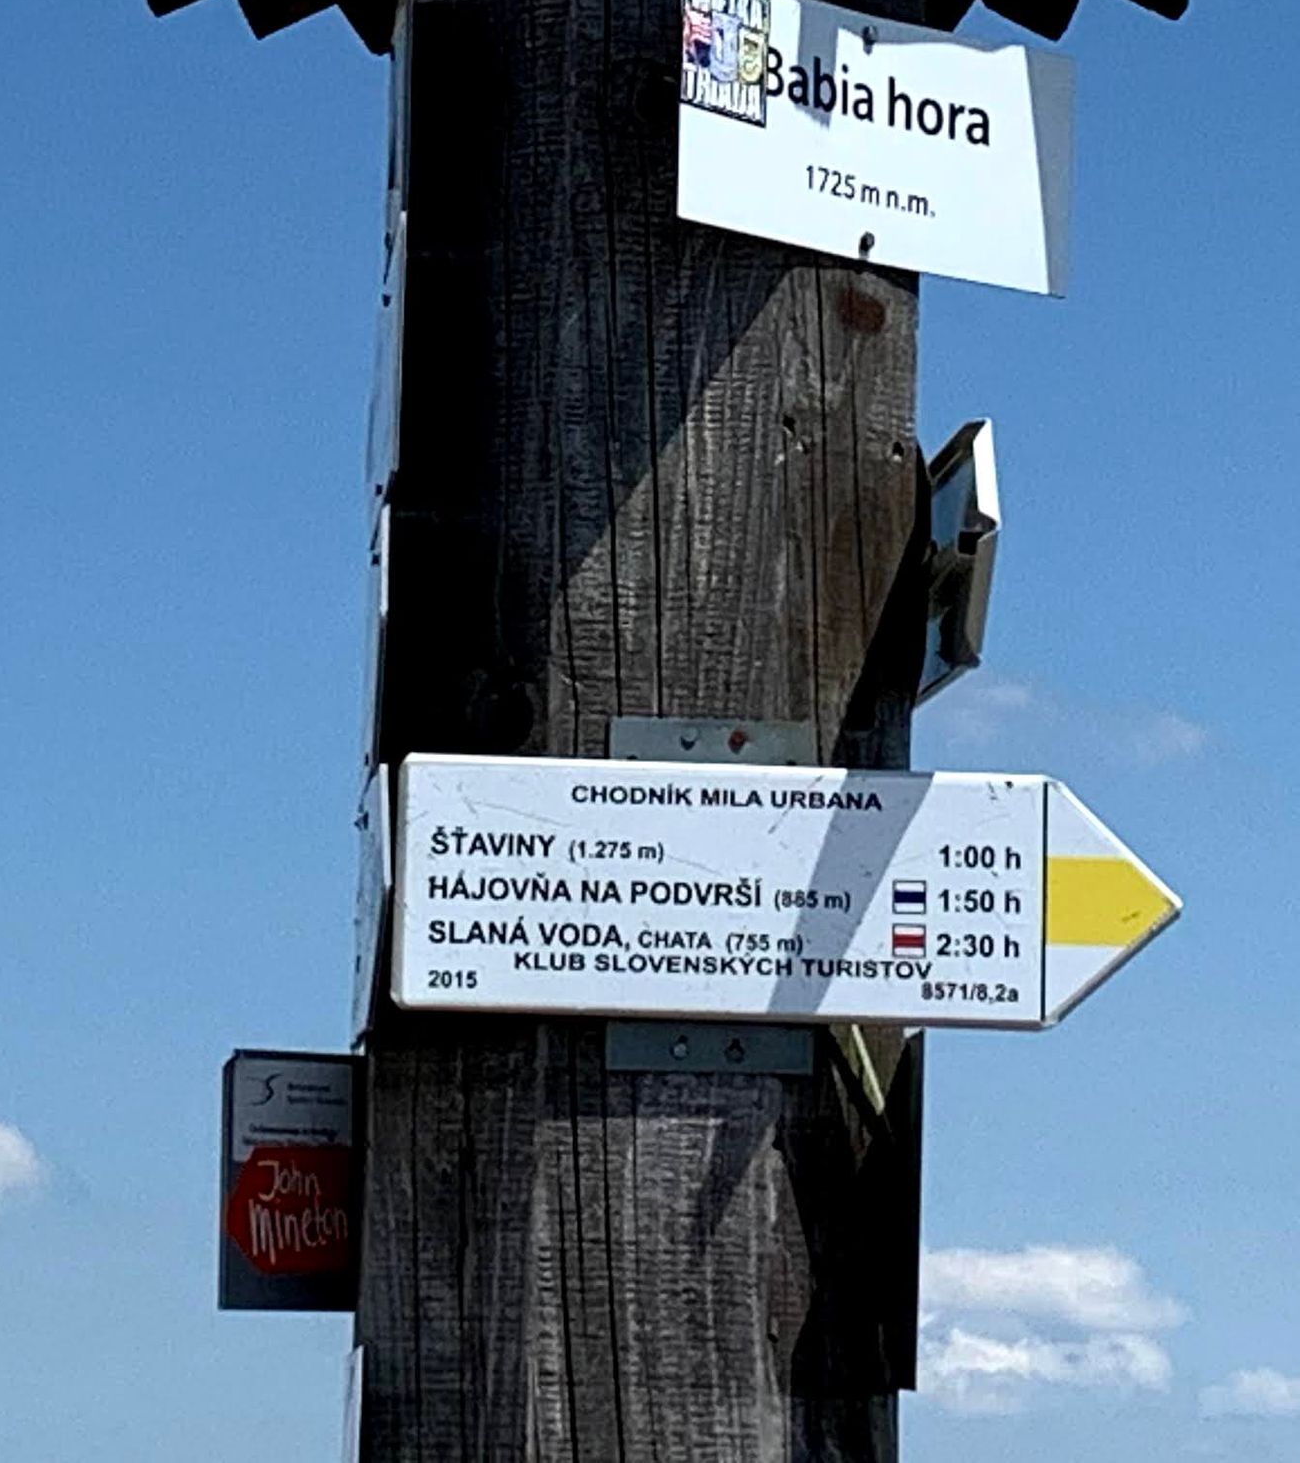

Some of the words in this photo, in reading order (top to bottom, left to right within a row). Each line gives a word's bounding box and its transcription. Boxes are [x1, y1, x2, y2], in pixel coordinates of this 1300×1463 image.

[767, 47, 874, 123] Babia
[888, 76, 990, 147] hora
[806, 165, 855, 200] 1725
[861, 181, 880, 206] m
[886, 187, 936, 218] n.m.
[570, 783, 693, 807] CHODNÍK
[700, 787, 763, 808] MILA
[770, 790, 883, 812] URBANA
[430, 826, 556, 859] ŠŤAVINY
[568, 840, 633, 863] (1.275
[637, 842, 665, 862] m)
[939, 845, 996, 869] 1:00
[1005, 846, 1022, 870] h
[427, 871, 572, 902] HÁJOVŇA
[580, 880, 621, 904] NA
[630, 878, 762, 907] PODVRŠÍ
[824, 893, 851, 911] m)
[937, 890, 994, 913] 1:50
[1004, 891, 1022, 915] h
[428, 917, 530, 946] SLANÁ
[538, 922, 631, 952] VODA,
[637, 931, 712, 950] CHATA
[725, 932, 770, 953] (755
[777, 935, 803, 955] m)
[936, 934, 994, 958] 2:30
[1003, 935, 1021, 959] h
[427, 970, 478, 989] 2015
[513, 952, 586, 972] KLUB
[594, 952, 792, 977] SLOVENSKÝCH
[802, 959, 933, 979] TURISTOV
[921, 982, 1019, 1004] 8571/8,2a
[257, 1160, 321, 1201] John
